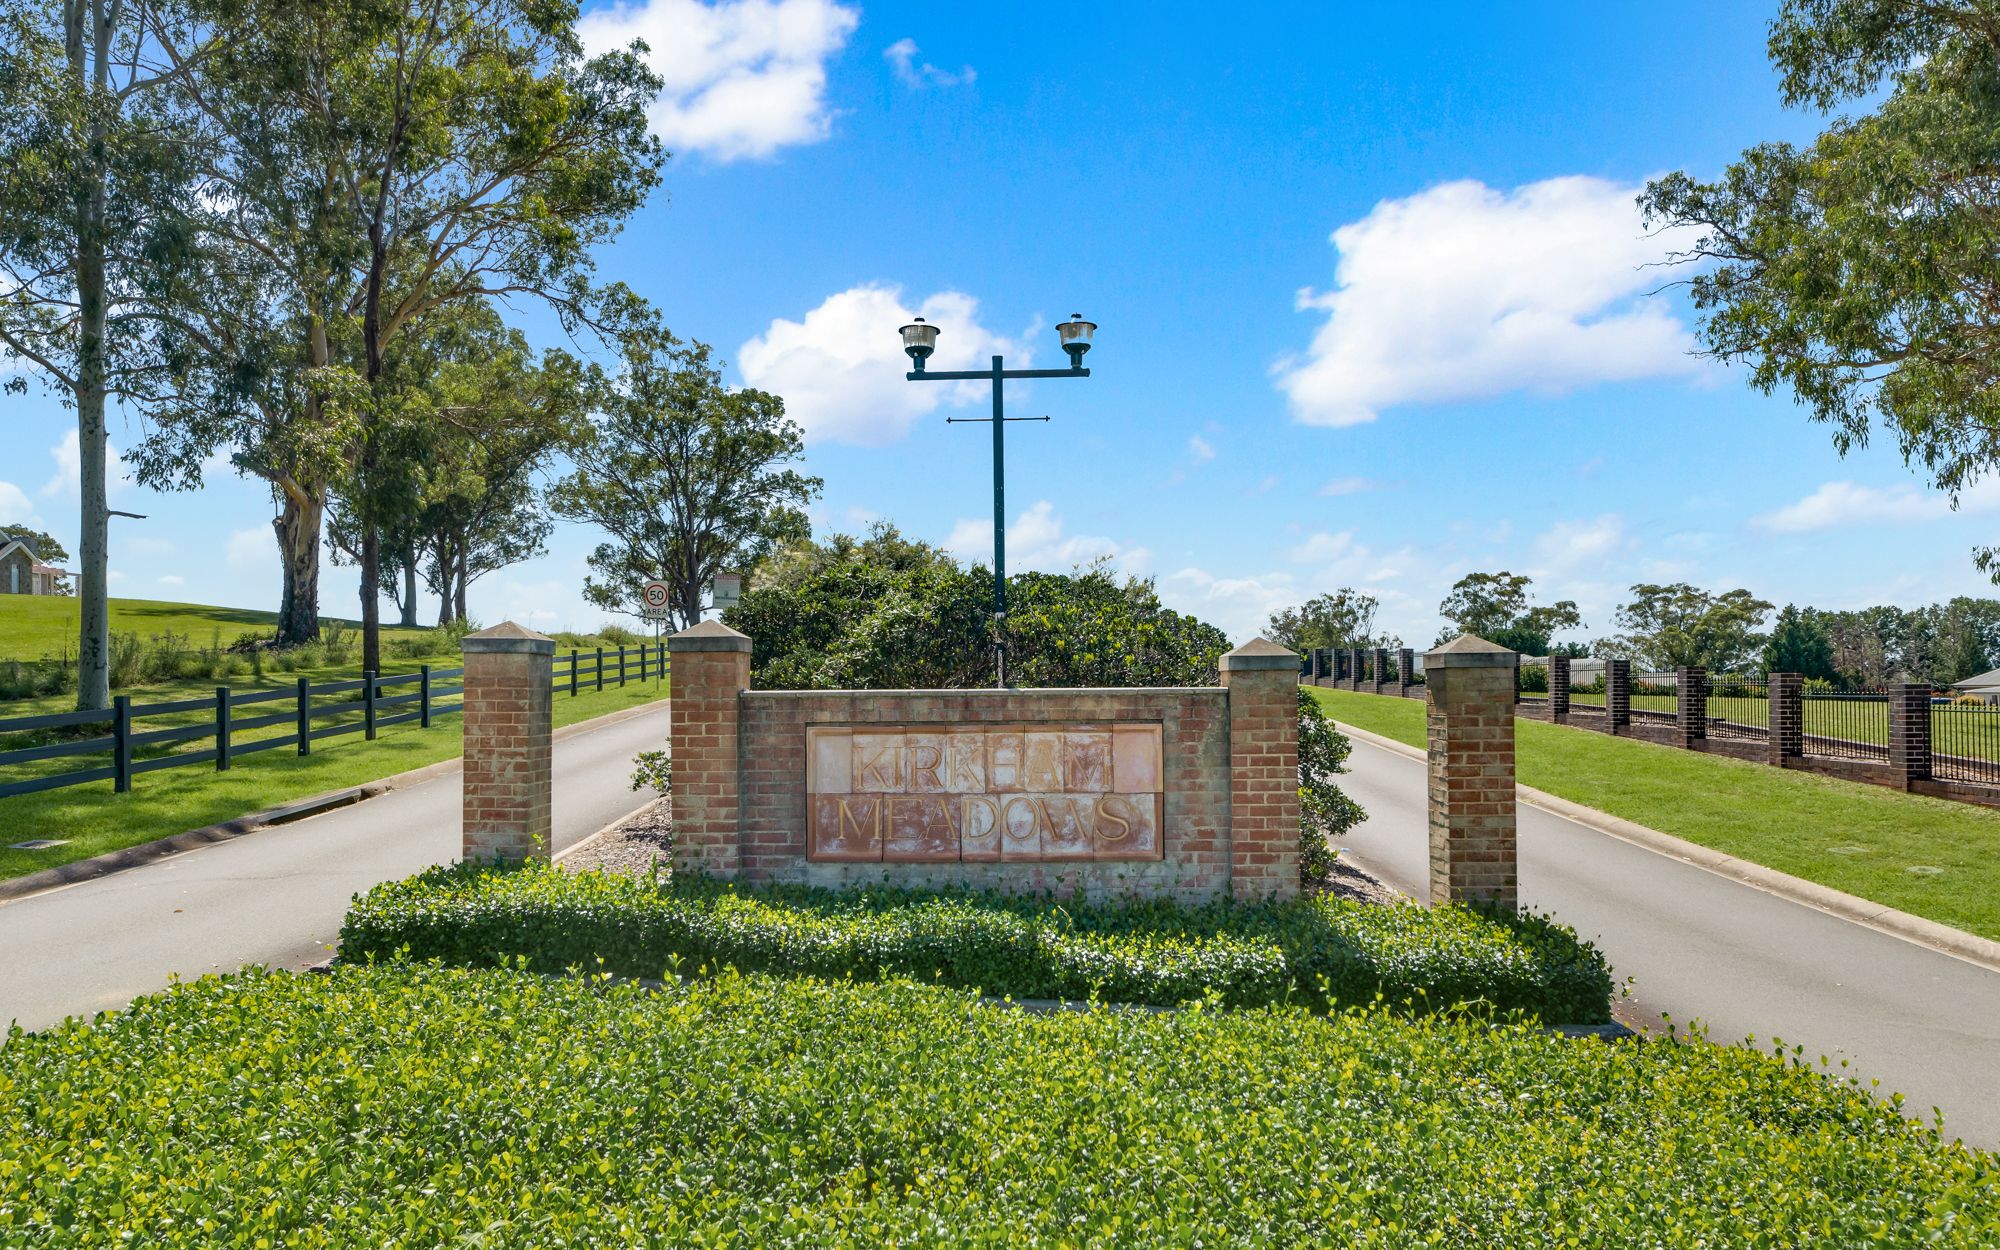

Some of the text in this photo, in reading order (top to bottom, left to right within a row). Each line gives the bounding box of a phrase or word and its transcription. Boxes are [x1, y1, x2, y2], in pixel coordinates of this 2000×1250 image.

[650, 590, 664, 601] 50
[647, 608, 668, 616] AREA
[854, 745, 1112, 790] KIRKHAM
[836, 797, 1131, 841] MEADOWS
